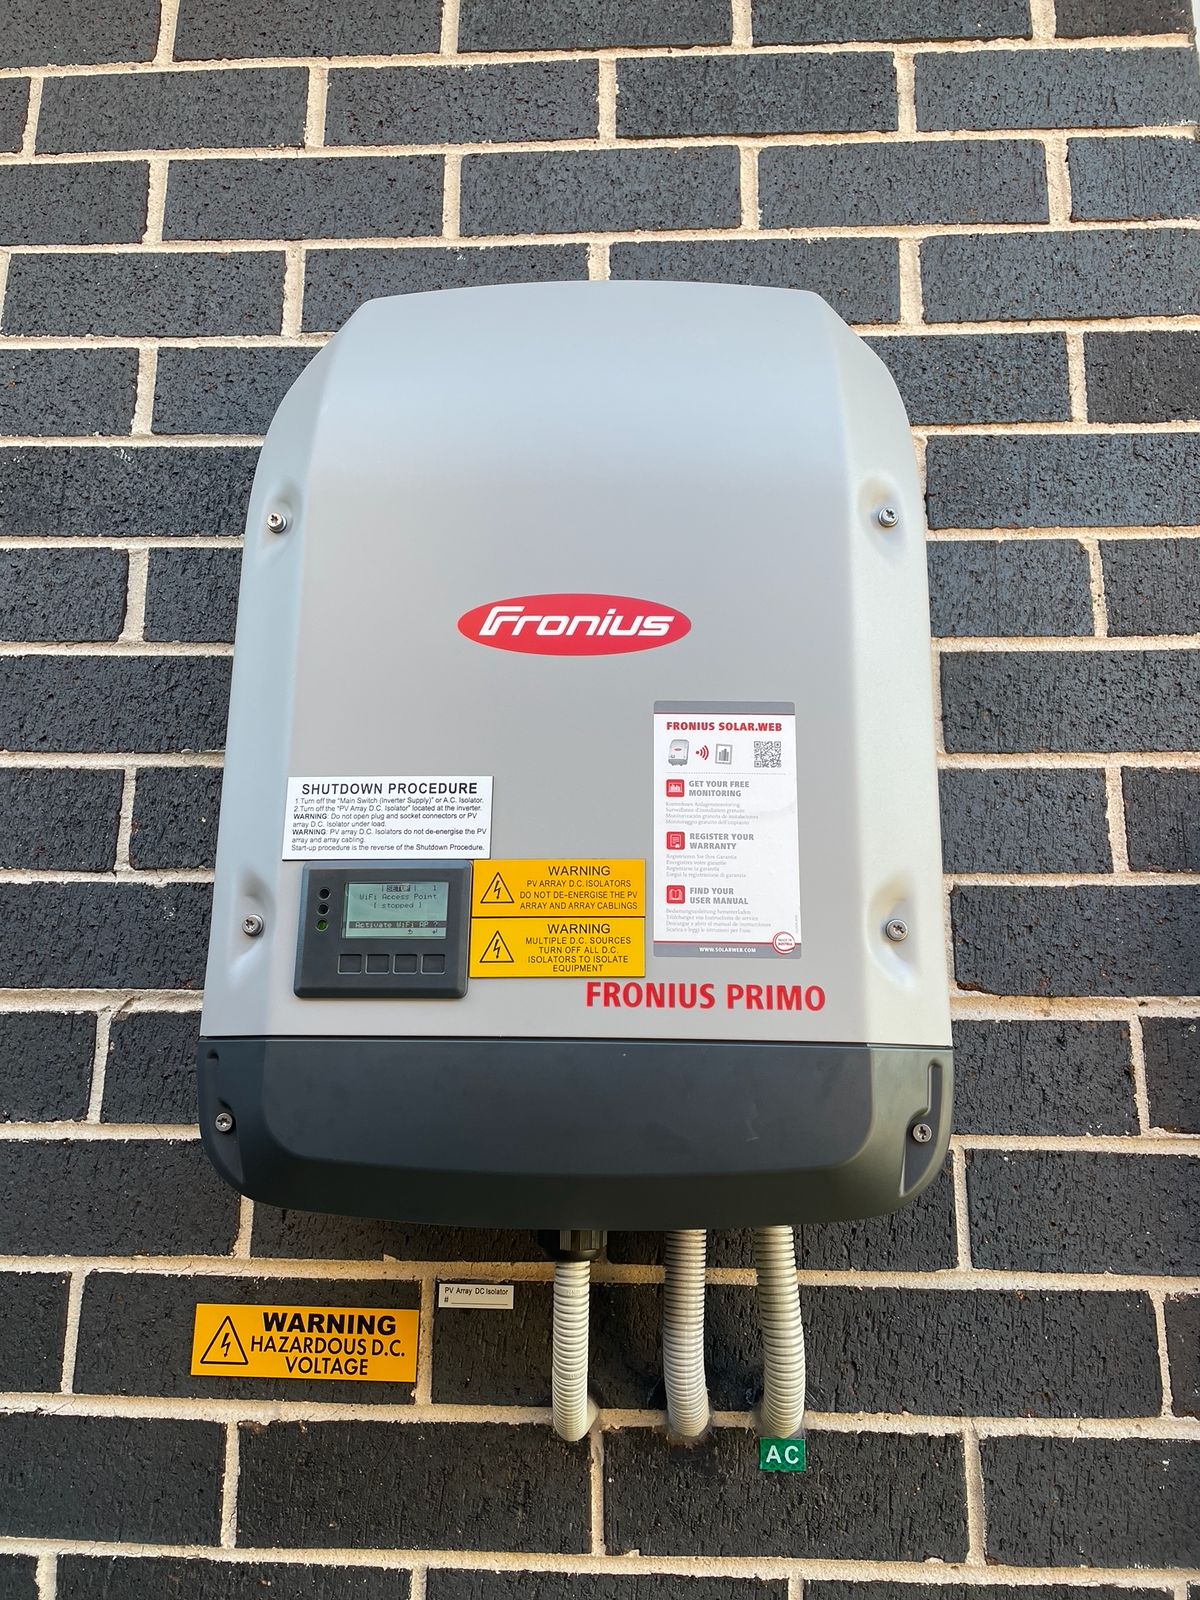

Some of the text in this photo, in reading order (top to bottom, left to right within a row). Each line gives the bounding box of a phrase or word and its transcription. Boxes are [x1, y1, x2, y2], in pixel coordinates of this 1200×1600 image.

[478, 605, 675, 636] Fronius
[666, 722, 782, 731] FRONIUS SOLAR.WEB
[302, 783, 478, 794] SHUTDOWN PROCEDURE
[548, 866, 611, 876] WARNING
[520, 891, 638, 899] DO NOT DE-ENERGISE THE PV
[520, 902, 638, 910] ARRAY AND ARRAY CABLINGS
[547, 923, 611, 934] WARNING
[552, 964, 604, 972] EQUIPMENT
[586, 982, 825, 1011] FRONIUS PRIMO
[456, 1288, 472, 1296] Array
[263, 1312, 396, 1336] WARNING
[250, 1336, 405, 1357] HAZARDOUS D.C.
[285, 1357, 369, 1376] VOLTAGE
[766, 1445, 799, 1464] AC
